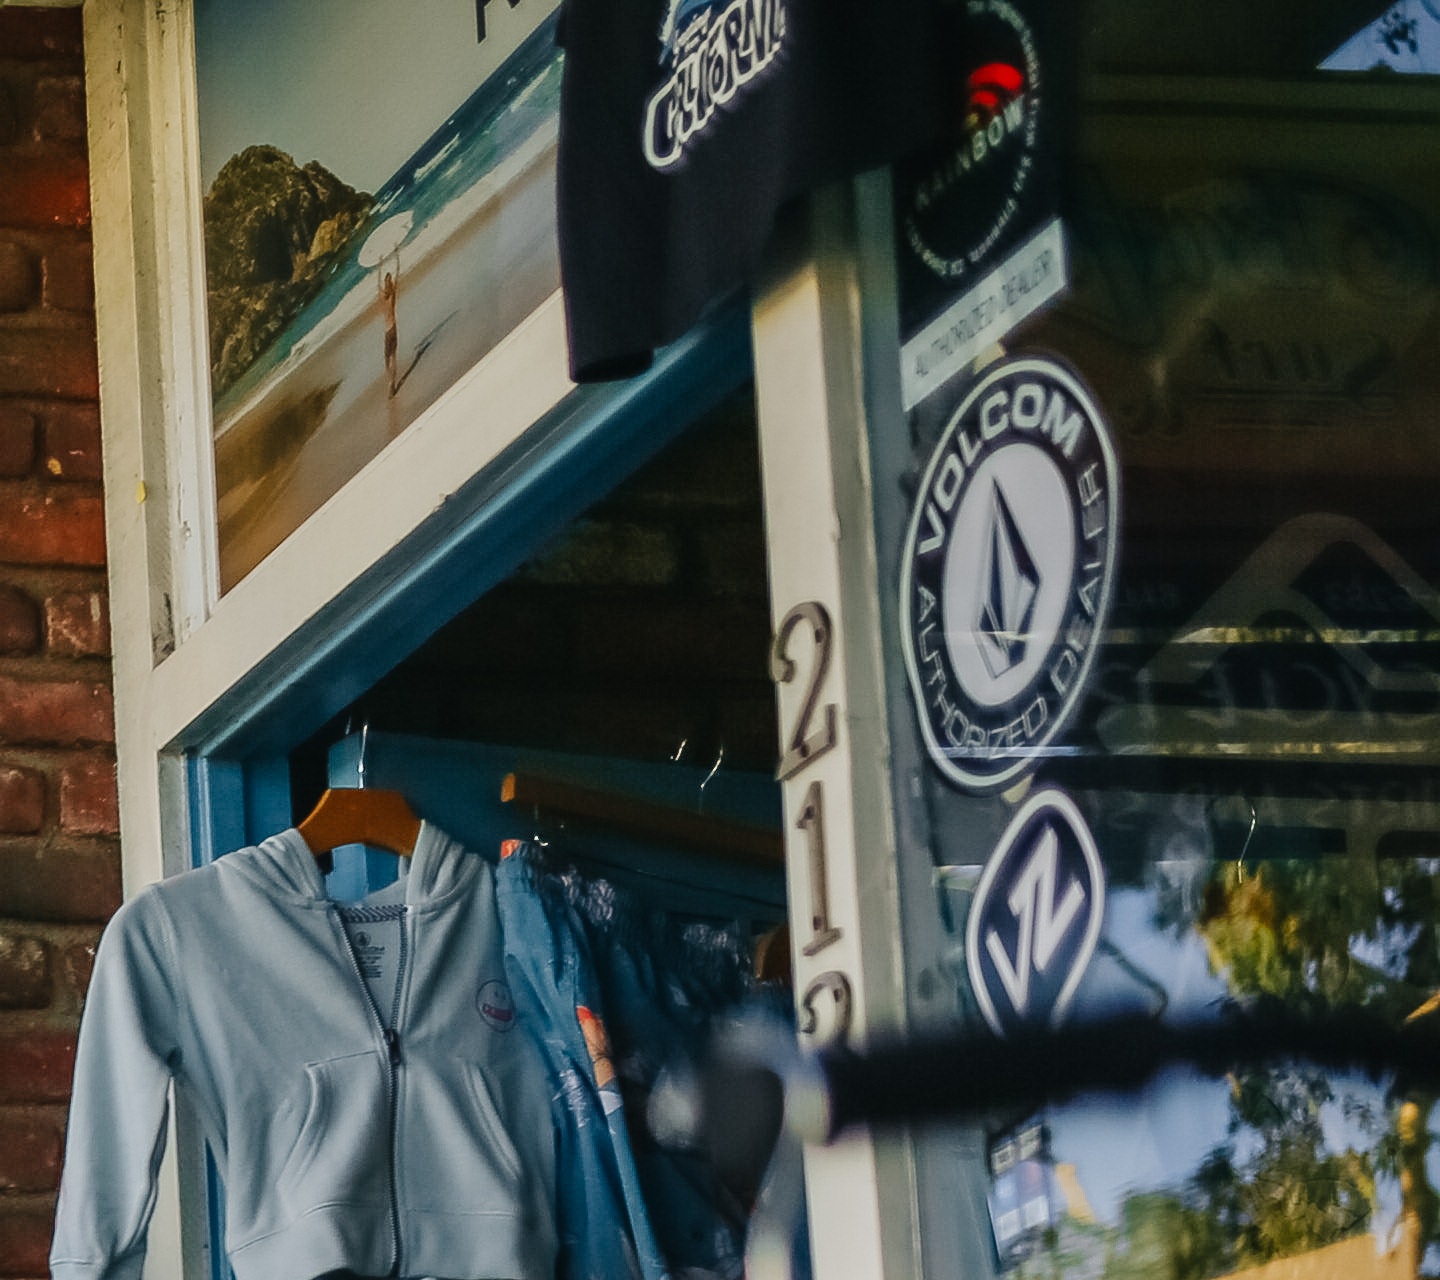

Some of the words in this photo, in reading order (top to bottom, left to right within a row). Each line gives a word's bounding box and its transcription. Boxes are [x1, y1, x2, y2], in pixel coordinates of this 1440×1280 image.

[915, 95, 1025, 213] RAINBOW
[917, 382, 1084, 556] VOLCOM
[917, 584, 1048, 760] AUTHORIZED
